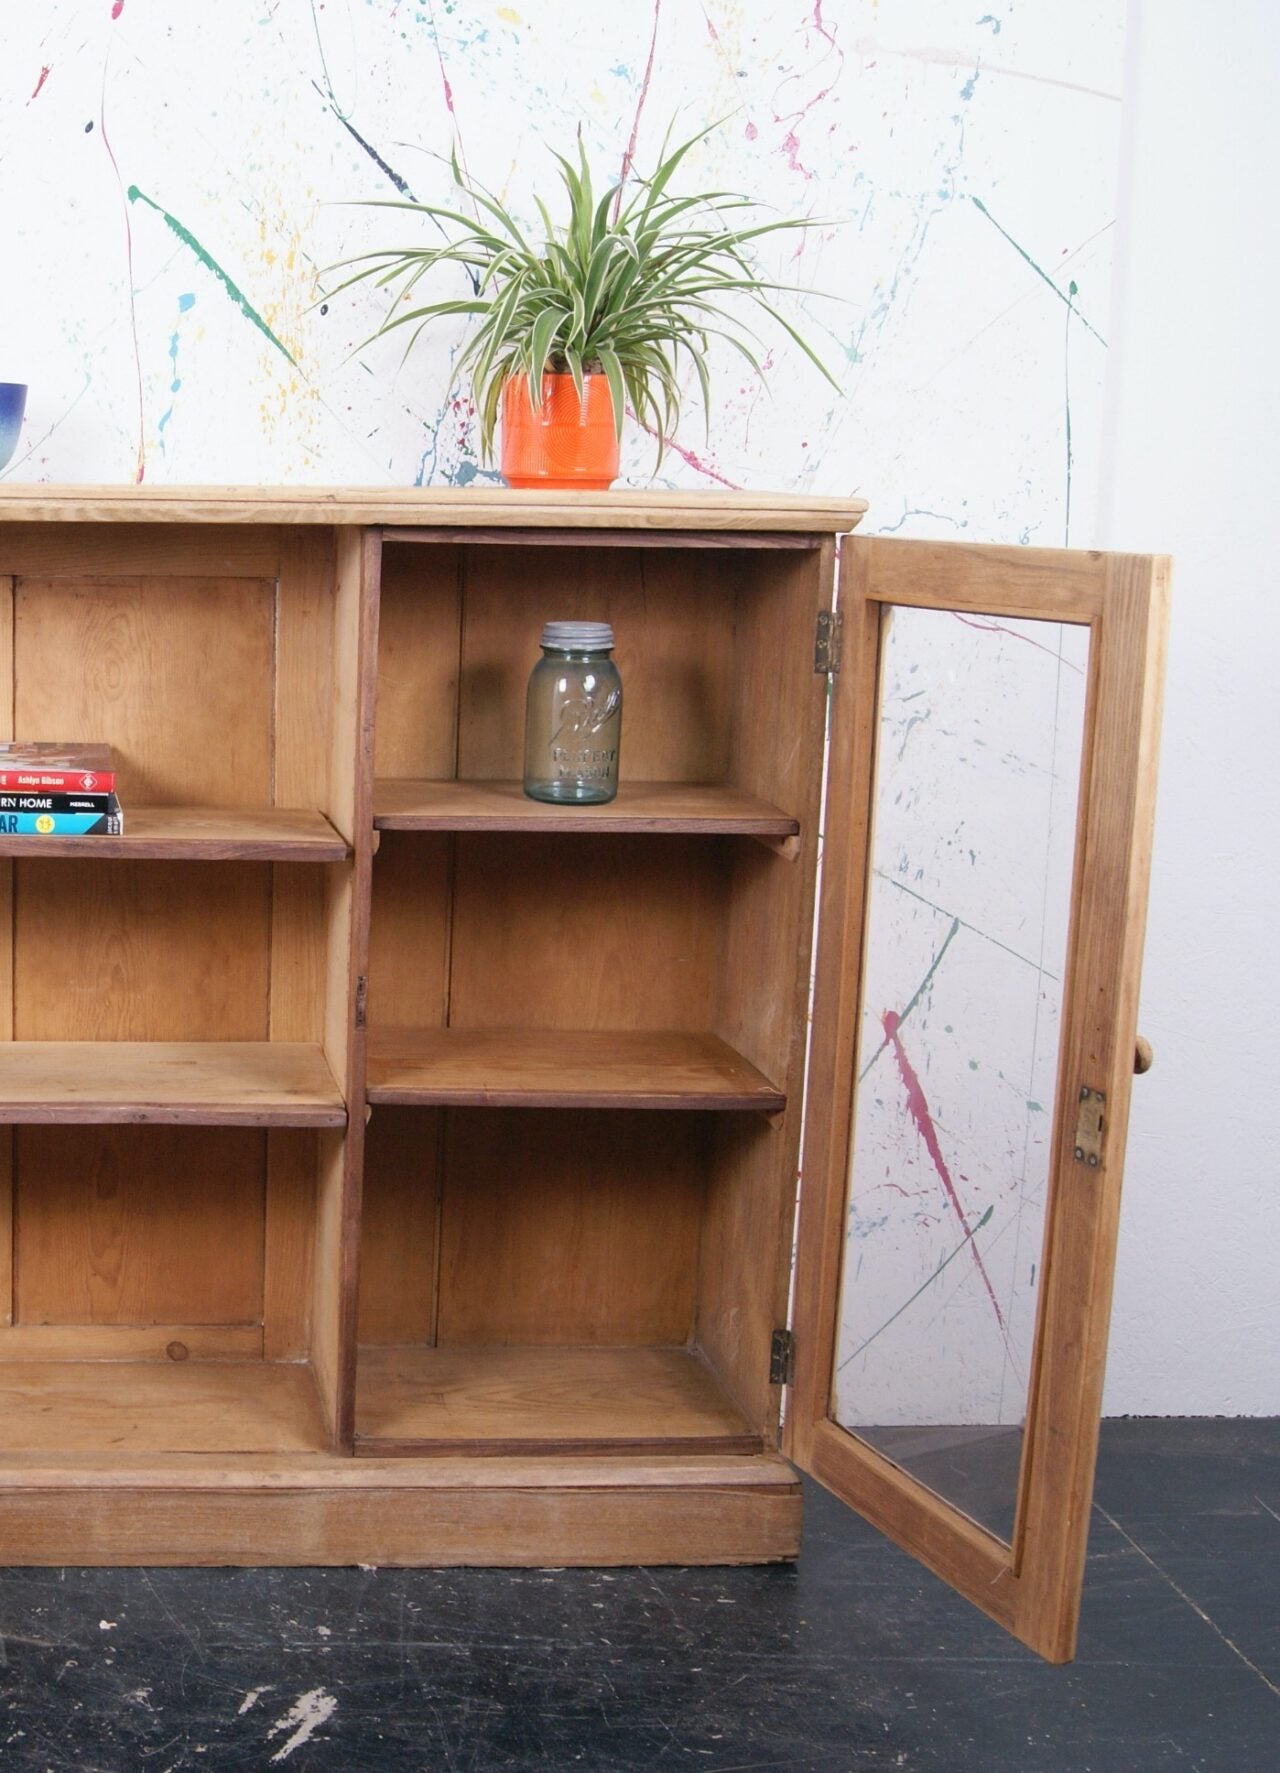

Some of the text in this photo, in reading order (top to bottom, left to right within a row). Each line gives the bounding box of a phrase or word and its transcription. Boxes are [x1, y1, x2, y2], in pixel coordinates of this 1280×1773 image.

[17, 776, 65, 786] Ashlyn Gibson
[19, 798, 53, 809] HOME
